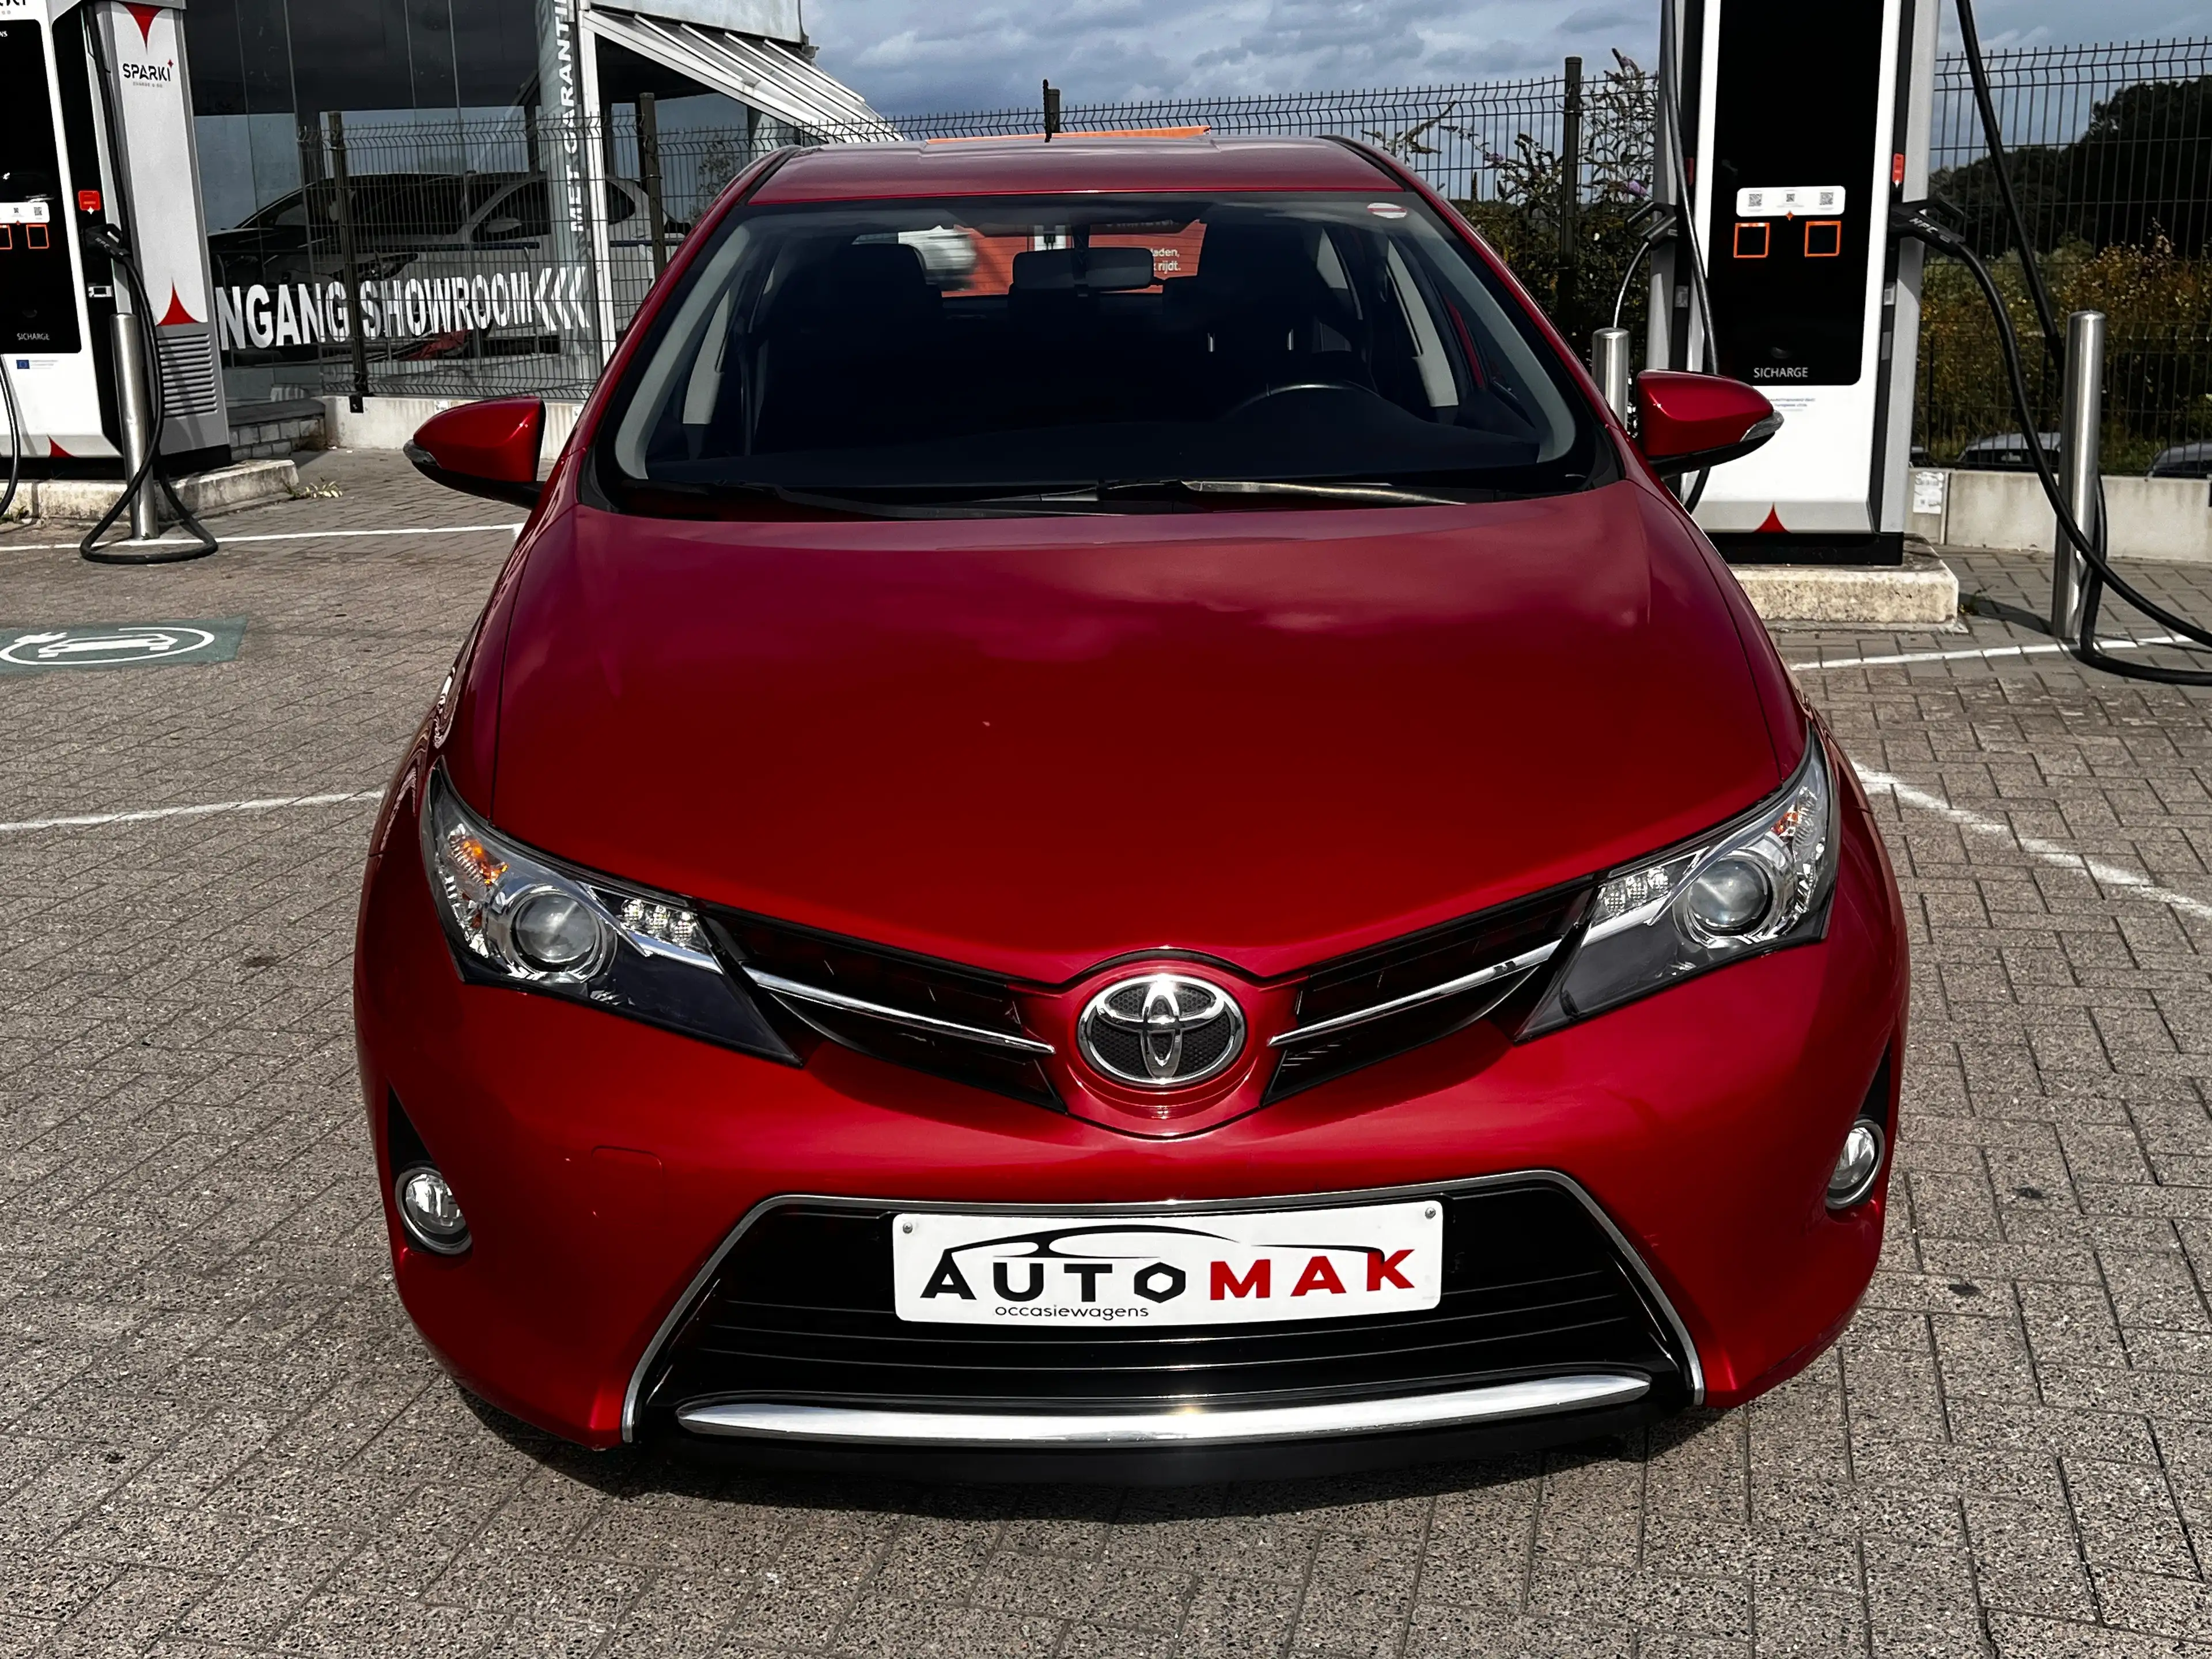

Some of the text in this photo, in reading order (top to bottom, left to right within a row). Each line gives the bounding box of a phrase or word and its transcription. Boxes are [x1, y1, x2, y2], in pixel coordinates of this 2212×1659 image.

[122, 62, 171, 82] SPARKI
[554, 0, 584, 231] MET GARANTI
[1158, 260, 1181, 274] rijdt.
[215, 271, 532, 351] NGANG SHOWROOM
[17, 332, 50, 340] SICHARGE
[1753, 367, 1809, 378] SICHARGE
[920, 1249, 1415, 1304] AUTOMAK
[995, 1305, 1150, 1321] occasiewagens
